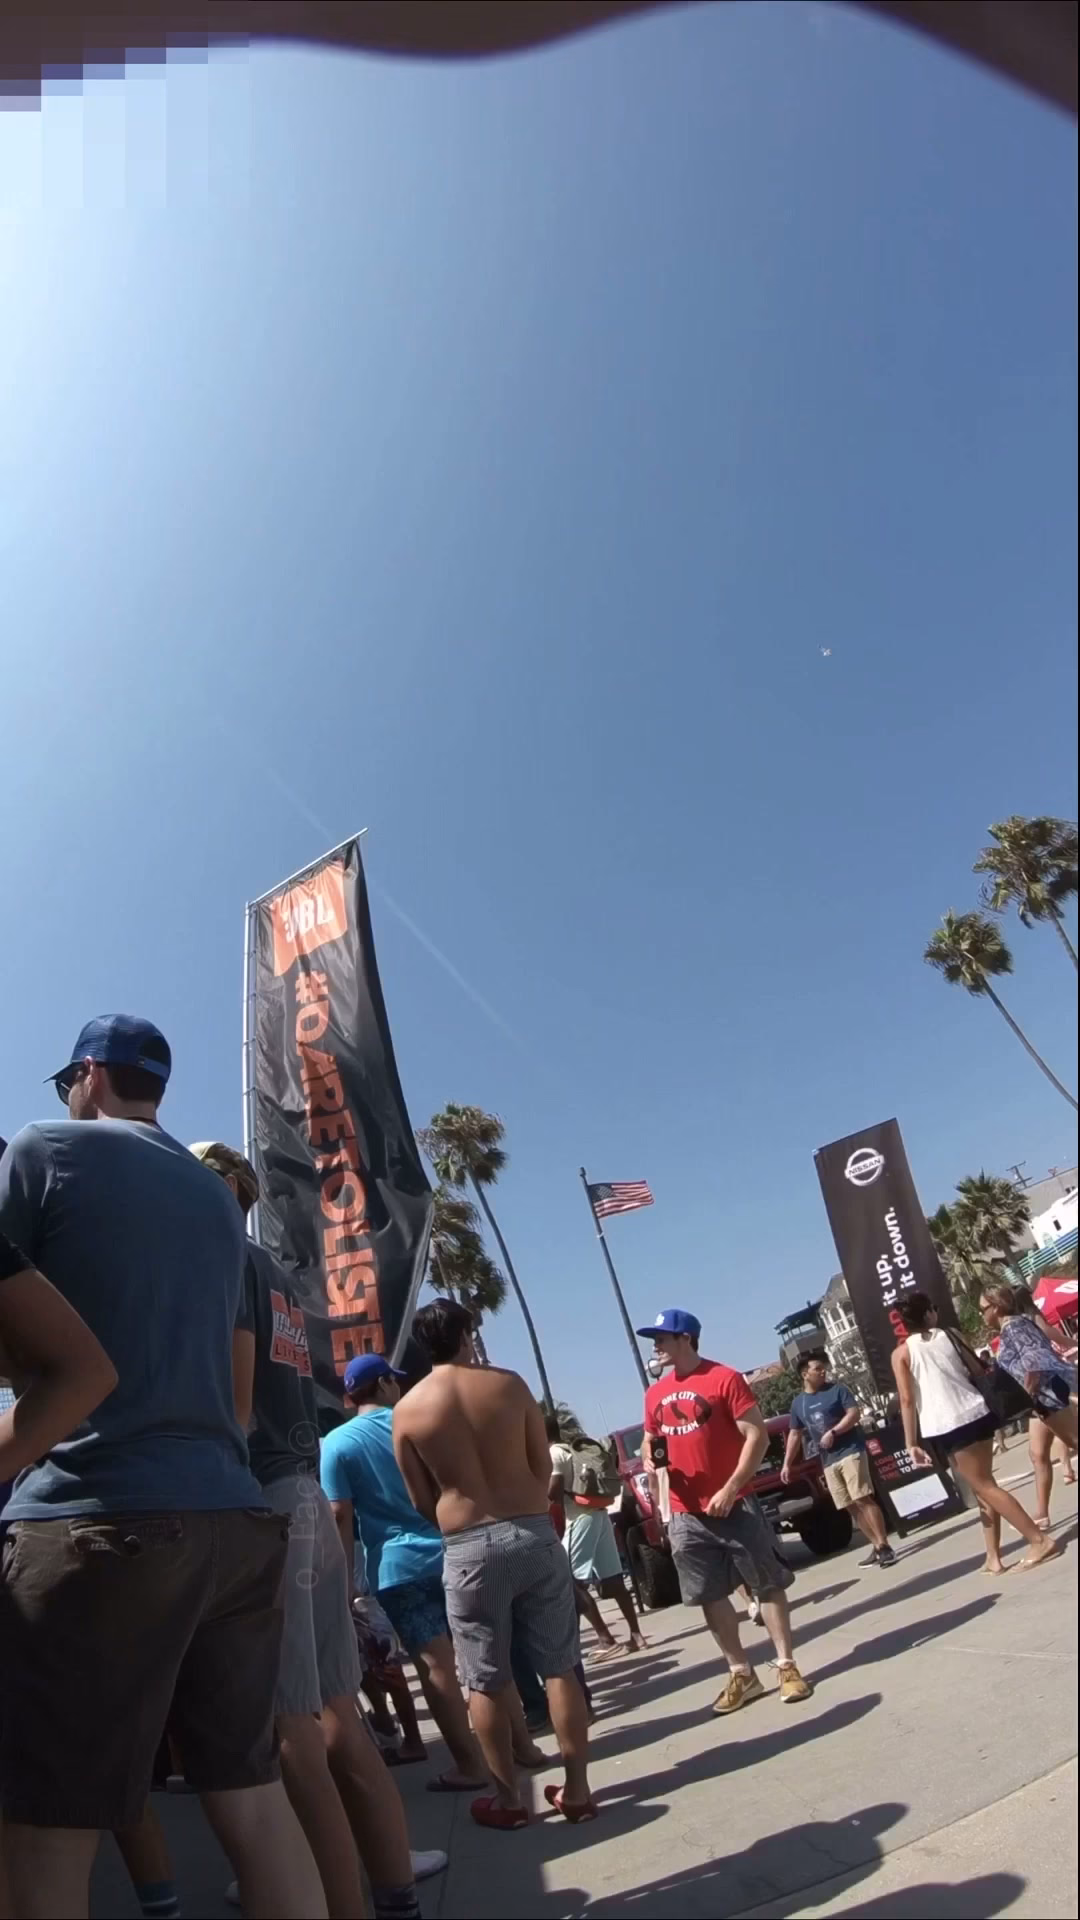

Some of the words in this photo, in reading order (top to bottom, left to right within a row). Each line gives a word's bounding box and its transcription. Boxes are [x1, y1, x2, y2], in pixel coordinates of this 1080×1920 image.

[284, 895, 334, 943] JBL
[848, 1159, 881, 1175] NISSAN
[295, 968, 386, 1409] #DARETOLISTE
[900, 1271, 917, 1289] it
[883, 1288, 899, 1307] it
[662, 1392, 677, 1405] ONE
[678, 1390, 697, 1401] CITY
[676, 1420, 699, 1436] TEAM
[900, 1465, 912, 1474] TO
